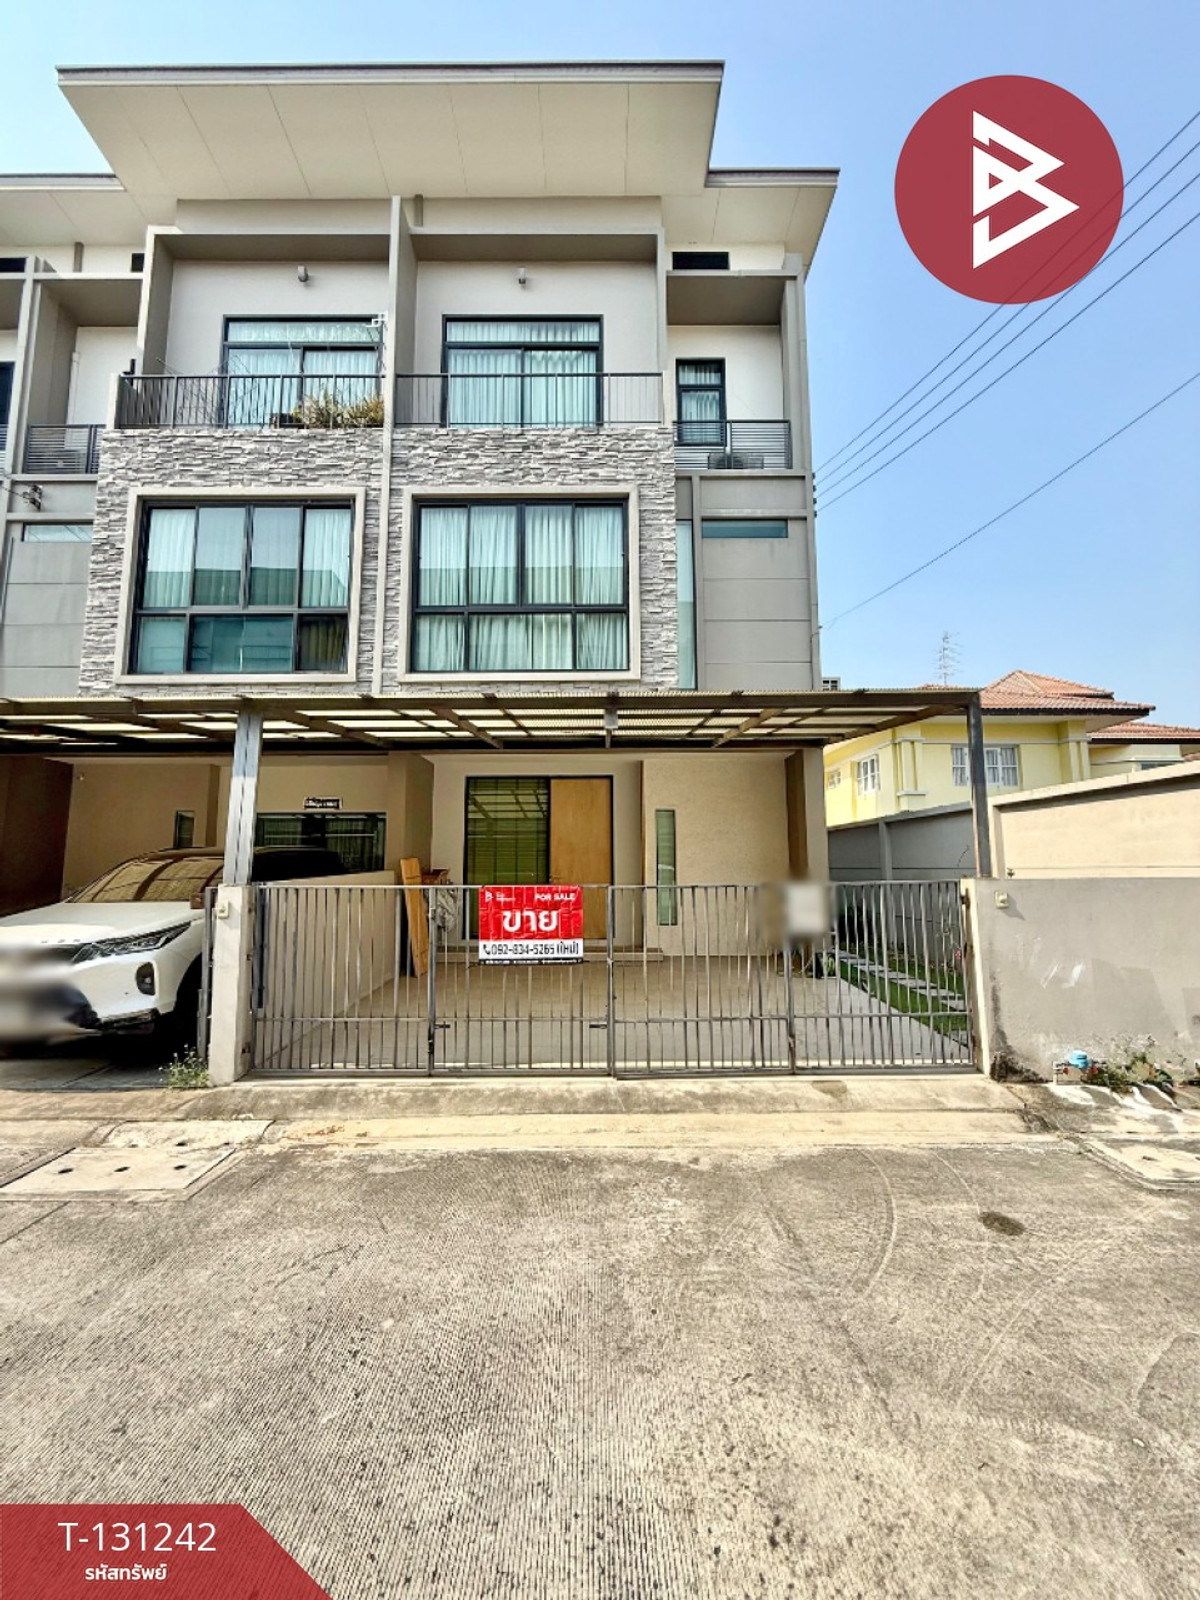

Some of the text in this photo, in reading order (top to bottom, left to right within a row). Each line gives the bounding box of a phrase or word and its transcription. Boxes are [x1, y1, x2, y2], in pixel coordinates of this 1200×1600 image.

[535, 893, 575, 901] FOR SALE
[502, 910, 558, 932] ขาย
